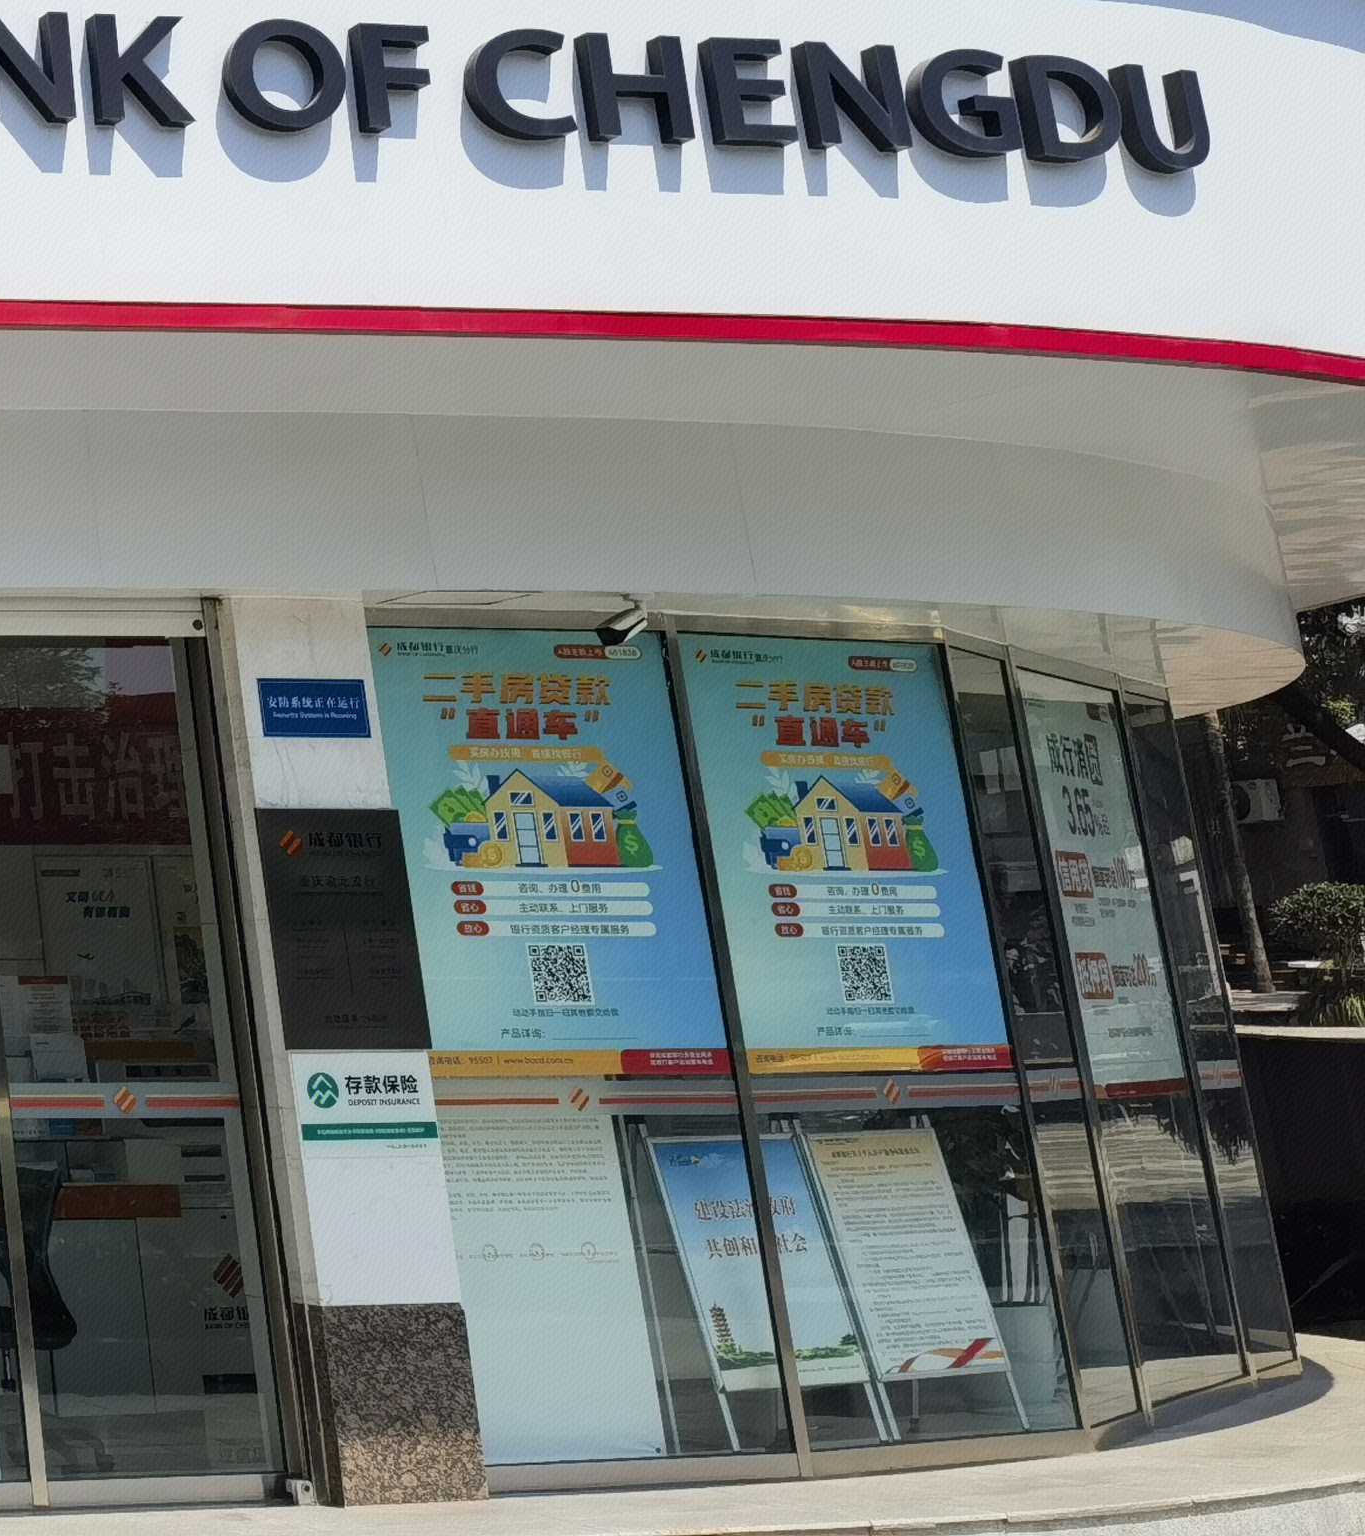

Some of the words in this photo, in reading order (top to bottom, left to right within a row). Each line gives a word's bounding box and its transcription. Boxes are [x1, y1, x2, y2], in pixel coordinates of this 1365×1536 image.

[221, 16, 431, 135] OF
[462, 27, 1209, 176] CHENGDU
[422, 671, 612, 706] 二手房贷款
[735, 680, 895, 716] 二手房贷款
[266, 696, 360, 710] 安防系统正在运行
[308, 832, 382, 848] 成都银行
[344, 1074, 419, 1096] 存款保险
[379, 1098, 420, 1106] INSURANCE
[706, 1233, 808, 1260] 共创和社会
